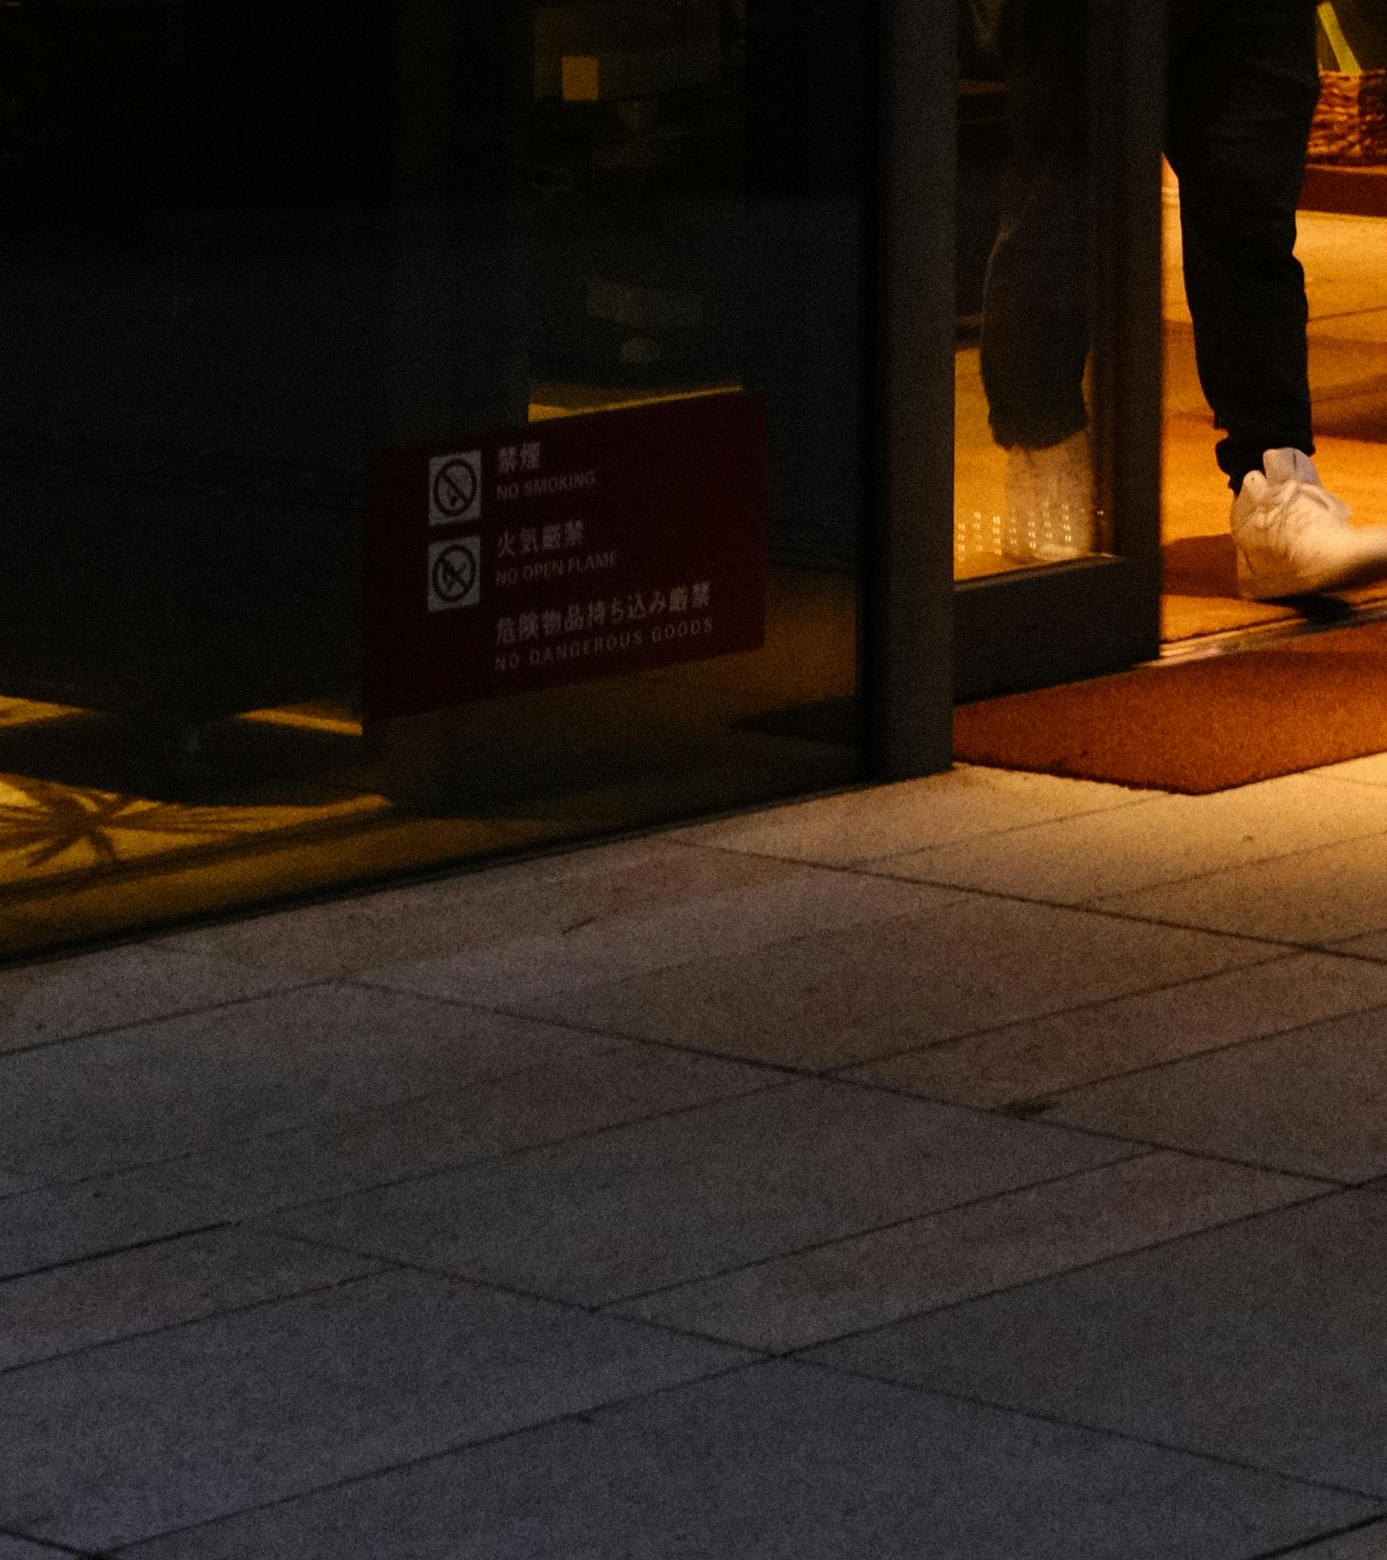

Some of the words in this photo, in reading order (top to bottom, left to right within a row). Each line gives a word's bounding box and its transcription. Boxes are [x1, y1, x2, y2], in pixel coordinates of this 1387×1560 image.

[496, 483, 519, 501] NO
[523, 469, 597, 497] SMOKING
[496, 519, 585, 560] 火気厳禁
[496, 569, 519, 587] NO
[522, 559, 564, 582] OPEN
[567, 550, 618, 574] FLAME
[494, 652, 520, 671] NO
[528, 630, 643, 666] DANGEROUS
[651, 616, 714, 644] GOODS
